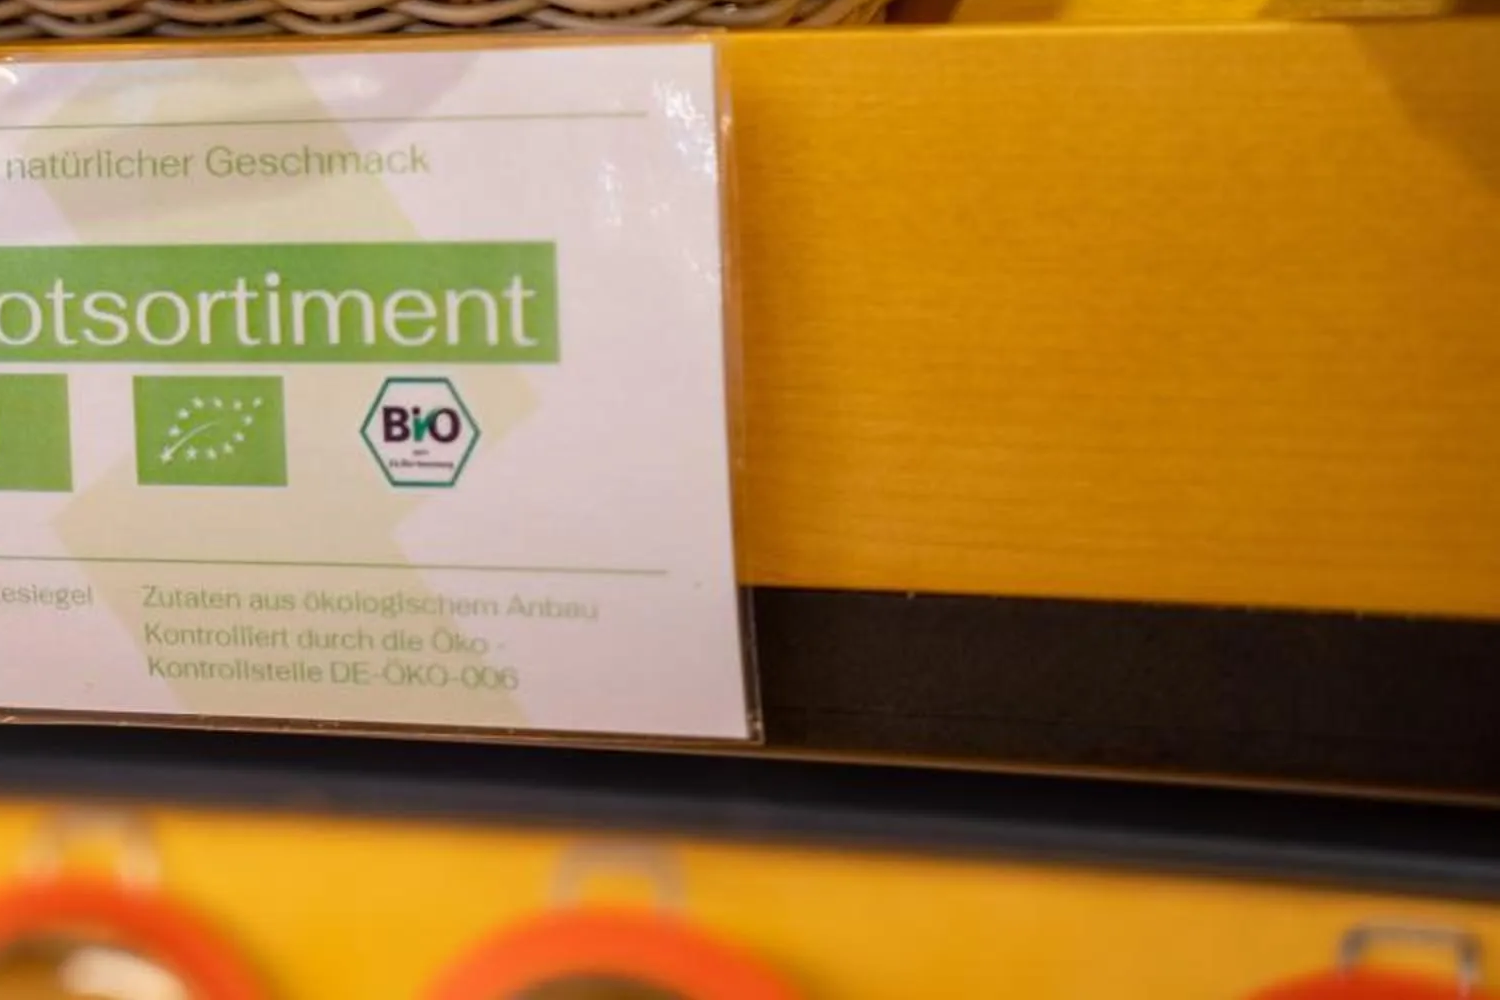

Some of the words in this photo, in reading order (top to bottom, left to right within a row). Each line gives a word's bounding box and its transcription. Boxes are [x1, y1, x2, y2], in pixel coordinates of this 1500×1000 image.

[7, 149, 194, 181] natürlicher
[205, 144, 431, 178] Geschmack
[142, 585, 242, 611] Zutaten
[249, 593, 296, 612] aus
[303, 589, 498, 619] ökologischem
[506, 594, 598, 620] Anbau
[144, 623, 289, 648] Kontrolliert
[297, 627, 374, 652] durch
[382, 627, 424, 652] die
[147, 656, 324, 683] Kontrollstelle
[330, 658, 519, 691] DE-ÖKO-006
